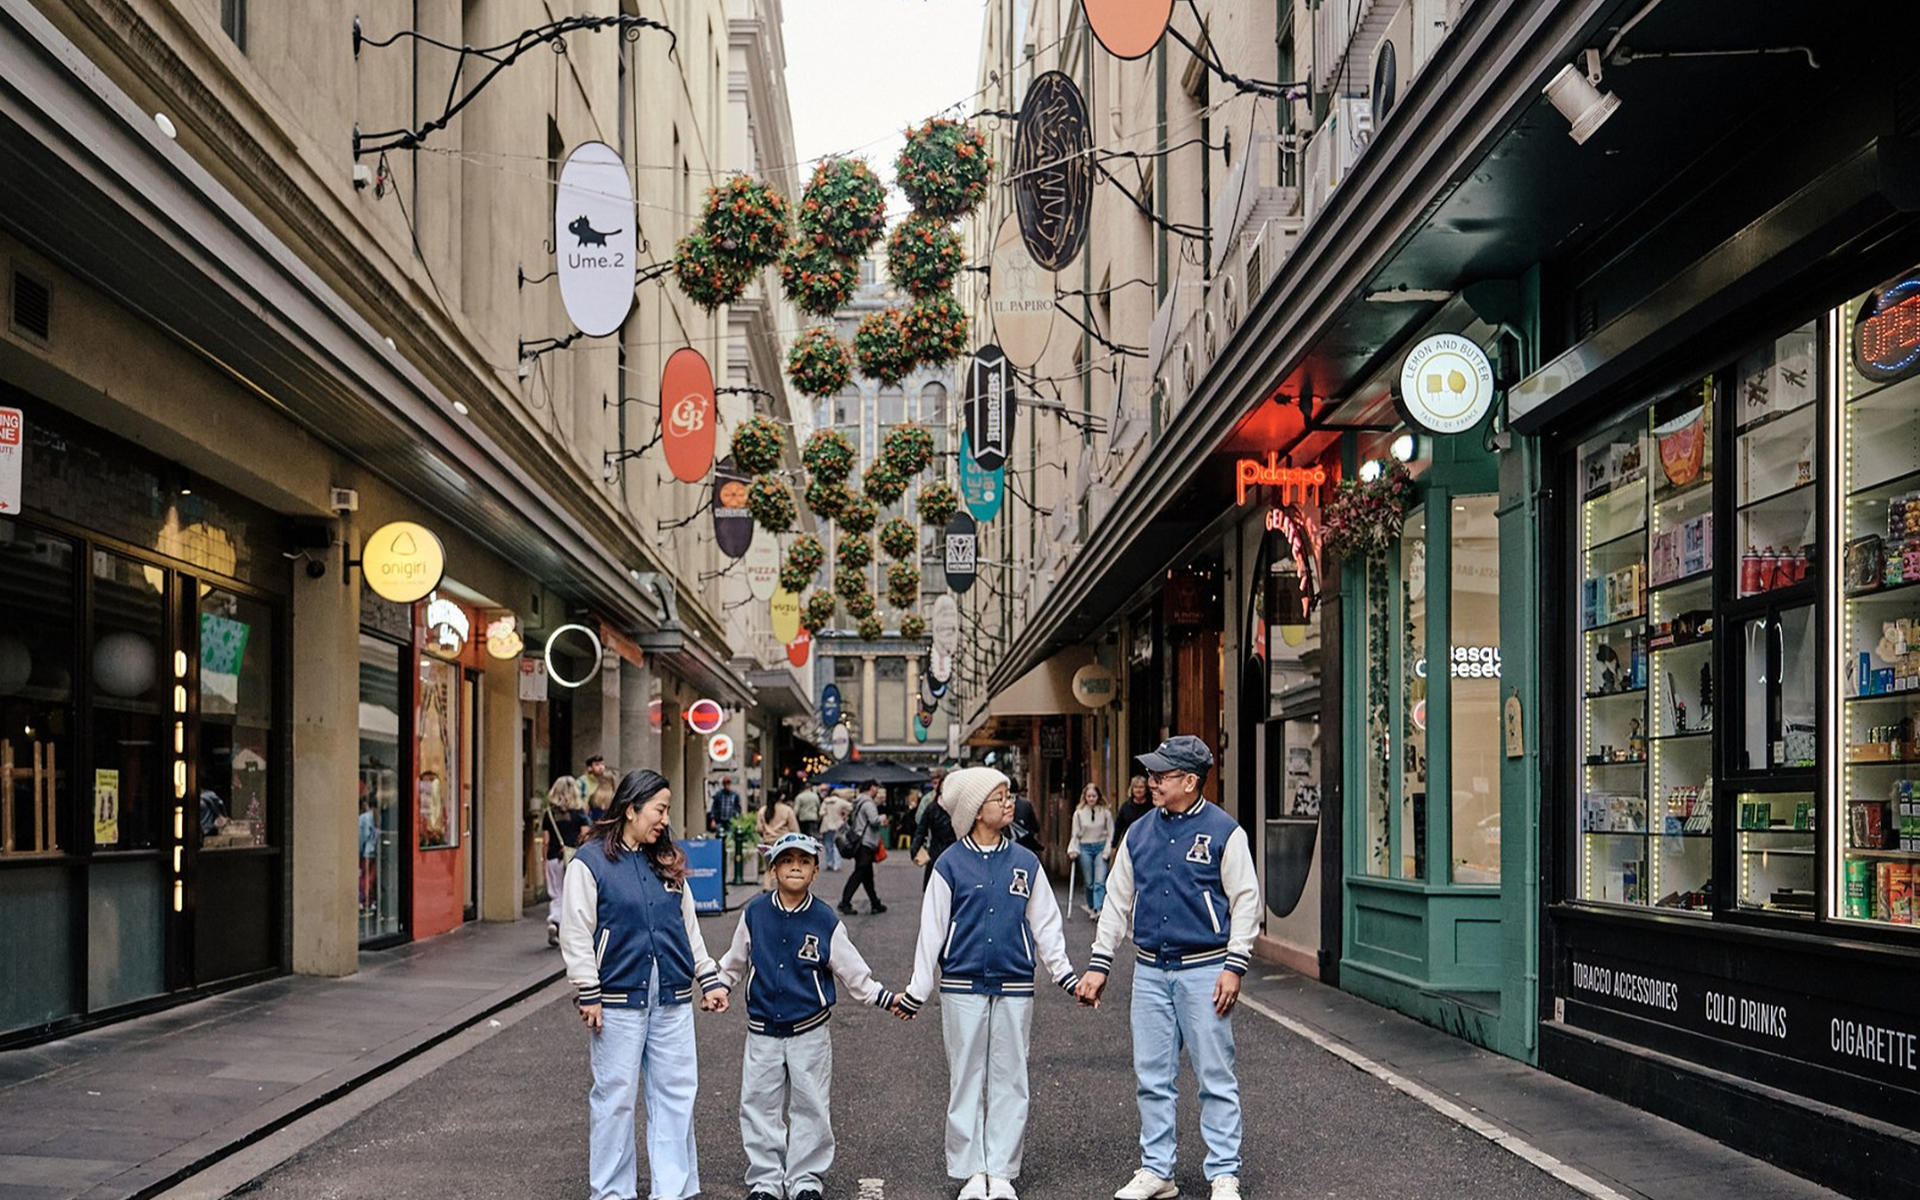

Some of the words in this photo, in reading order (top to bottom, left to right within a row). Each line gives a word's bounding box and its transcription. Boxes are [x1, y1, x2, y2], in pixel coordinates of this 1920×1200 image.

[568, 252, 625, 269] Ume.2
[995, 301, 1006, 312] IL
[1010, 300, 1053, 312] PAPIRO
[1863, 293, 1920, 362] OPE
[1406, 345, 1432, 379] LEMON
[1436, 339, 1458, 350] AND
[1460, 343, 1490, 382] BUTTER
[1420, 410, 1440, 426] TASTE
[1456, 408, 1478, 426] FRANCE
[381, 561, 427, 579] onigiri
[748, 566, 777, 575] PIZZA
[1450, 645, 1501, 665] asqu
[1573, 961, 1612, 996] TOBACCO
[1613, 971, 1678, 1012] ACCESSORIES
[1705, 991, 1736, 1026] COLD
[1740, 998, 1787, 1039] DRINKS
[1831, 1018, 1917, 1071] CIGARETTE
